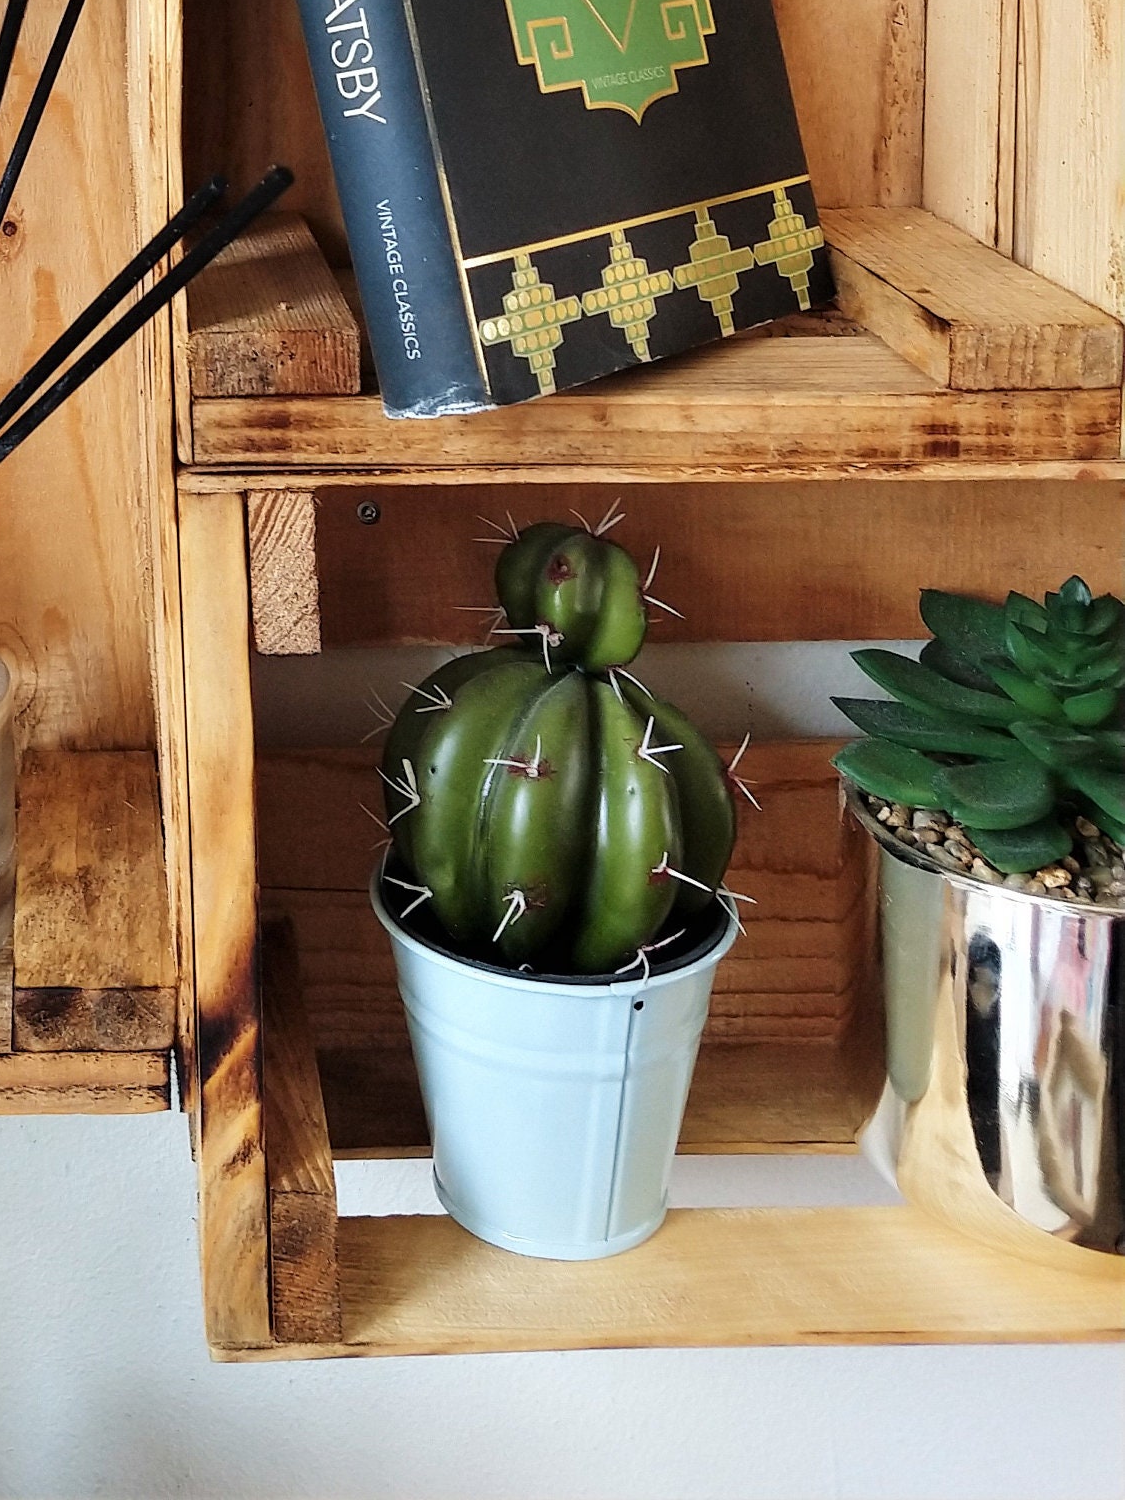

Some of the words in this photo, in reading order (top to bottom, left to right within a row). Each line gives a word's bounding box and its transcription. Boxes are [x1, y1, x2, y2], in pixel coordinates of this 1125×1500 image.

[592, 73, 628, 90] VINTAGE
[628, 65, 666, 83] CLASSICS
[376, 199, 405, 275] VINTAGE
[392, 279, 422, 361] CLASSICS
